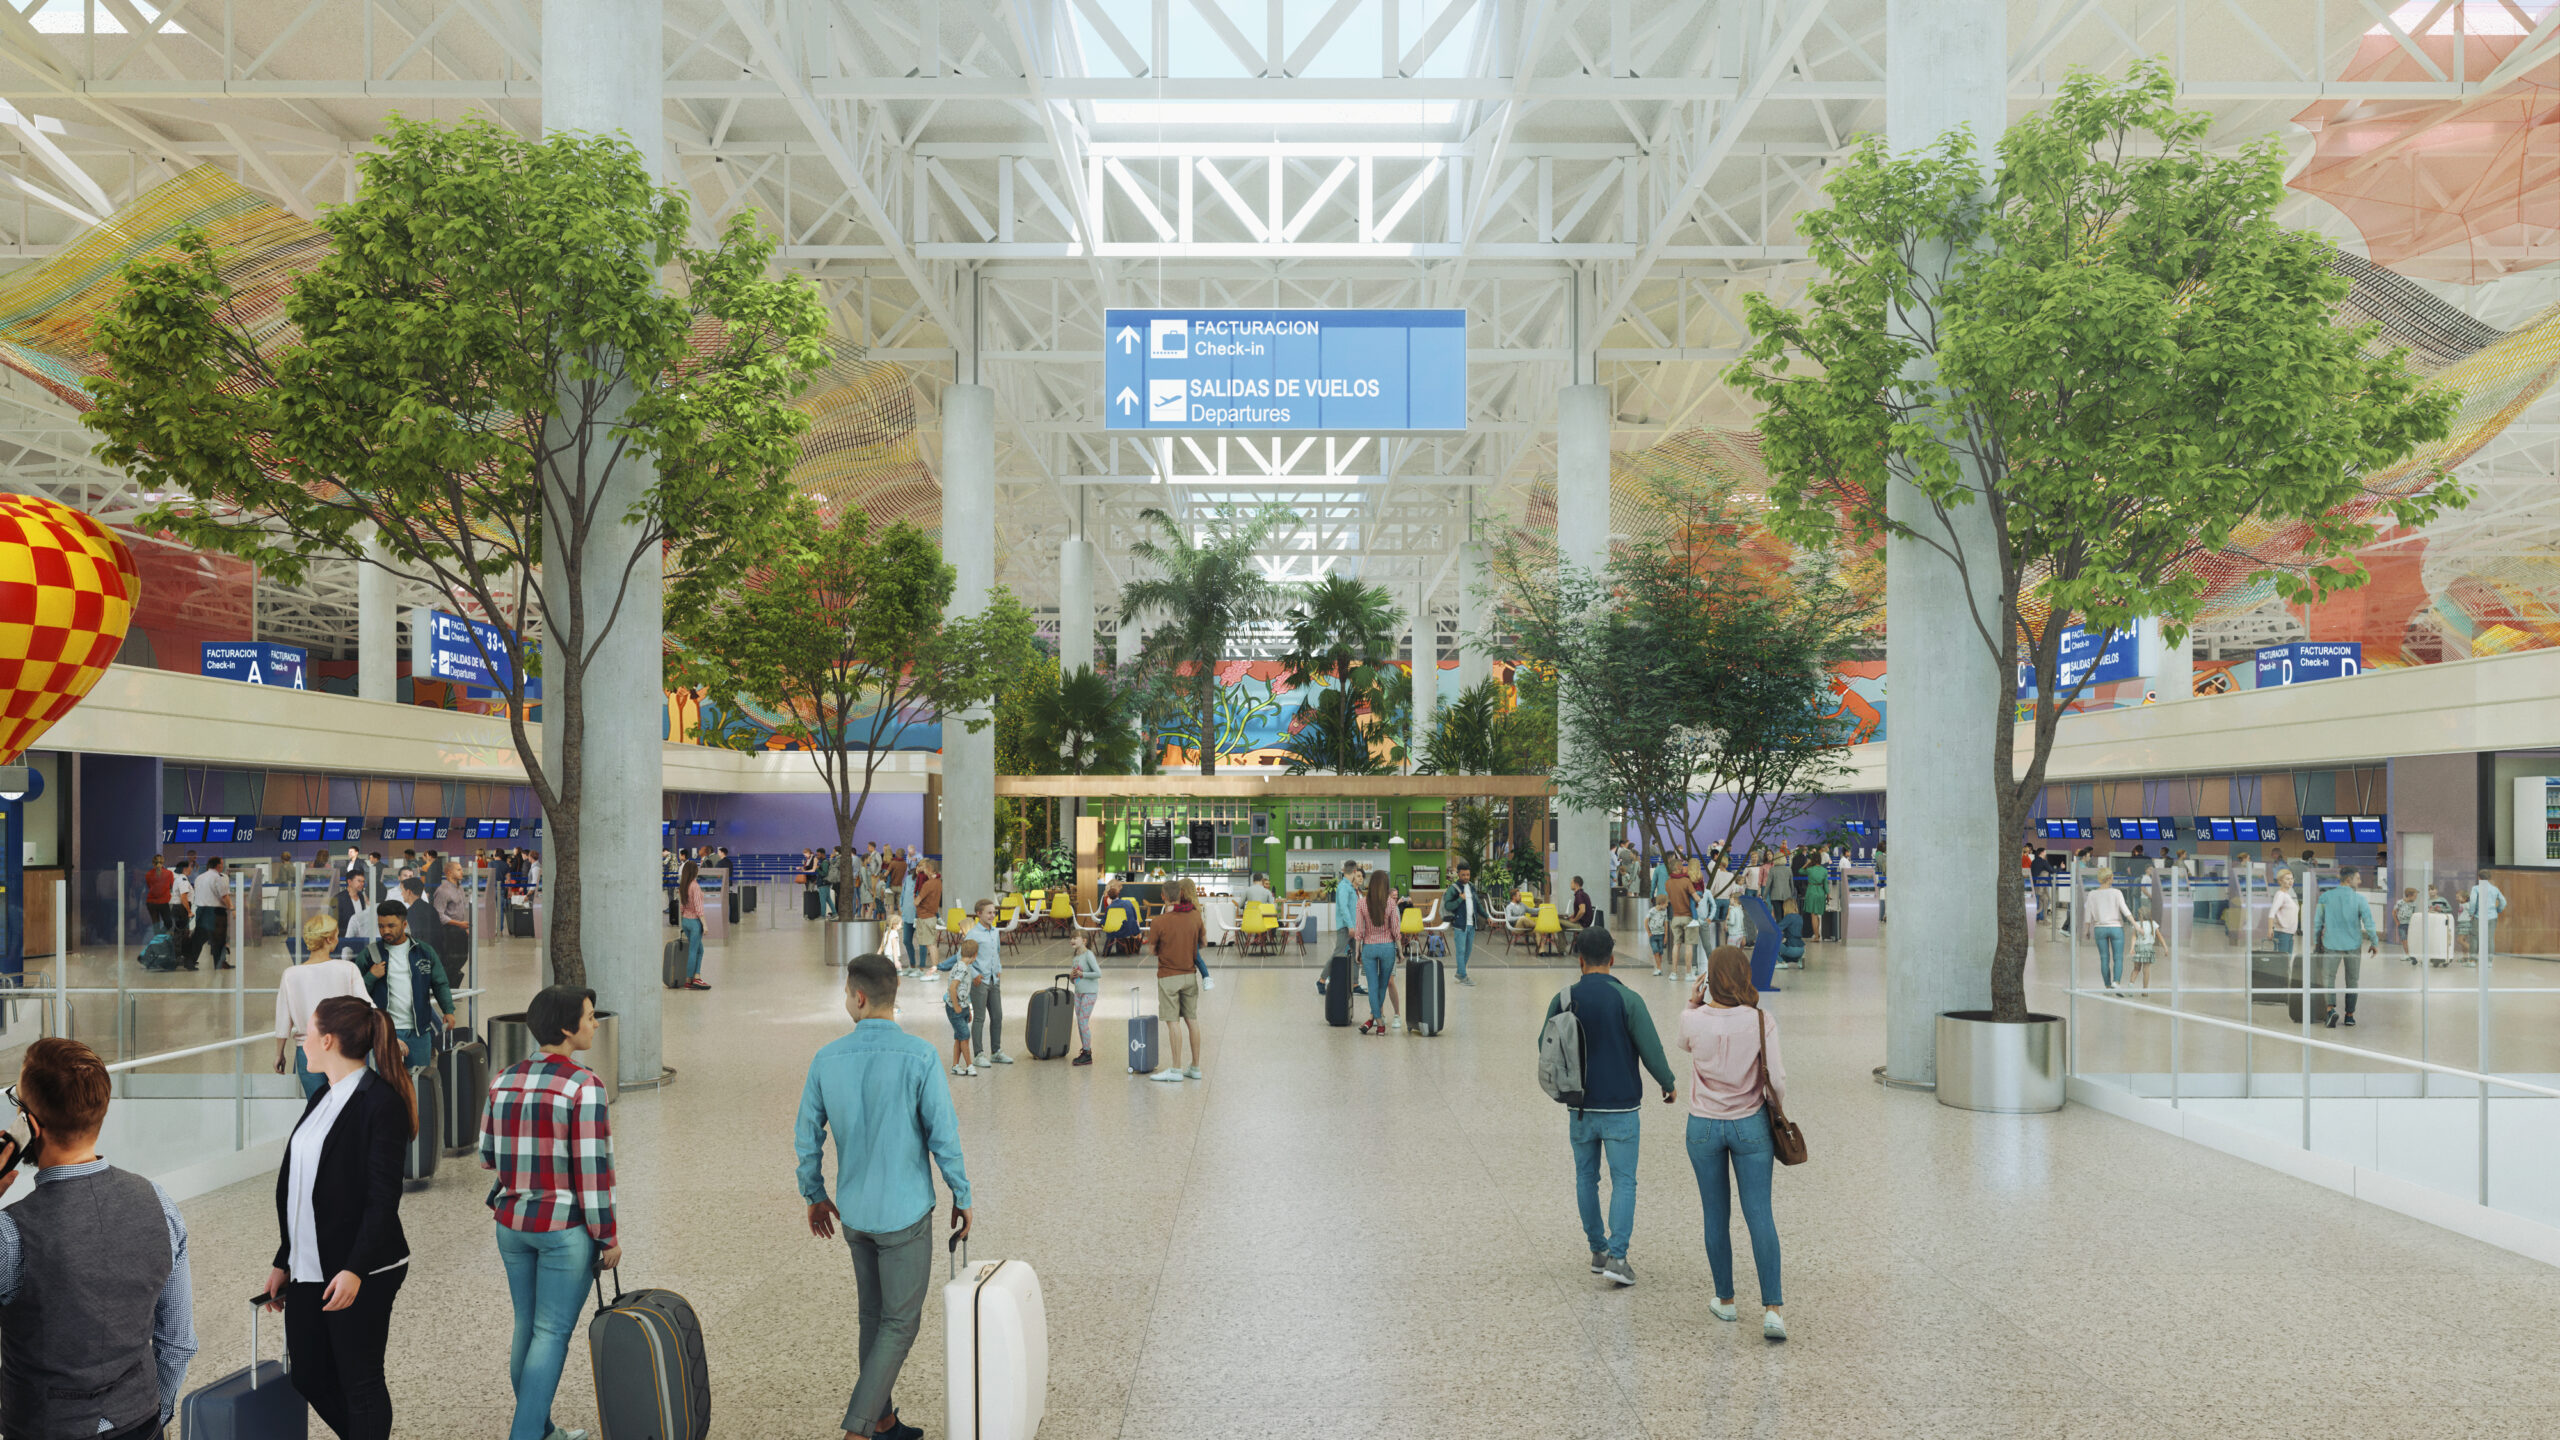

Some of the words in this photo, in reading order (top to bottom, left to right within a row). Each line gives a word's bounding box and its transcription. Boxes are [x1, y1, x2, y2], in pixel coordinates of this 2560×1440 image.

[1195, 321, 1320, 336] FACTURACION
[1195, 341, 1265, 356] Check-in
[1190, 379, 1270, 398] SALIDAS
[1275, 379, 1300, 398] DE
[1305, 379, 1380, 398] VUELOS
[1191, 404, 1291, 426] Departures
[451, 620, 484, 636] FACTUCION
[451, 631, 470, 643] Check-in
[2072, 640, 2090, 650] Check-in
[2300, 646, 2351, 655] FACTURACION
[207, 649, 257, 658] FACTURACION
[270, 650, 300, 663] FACTURACION
[2259, 648, 2289, 660] FACTURACION
[207, 660, 235, 669] Check-in
[270, 661, 288, 672] Check-in
[449, 652, 471, 667] SALIDAS
[472, 656, 479, 668] DE
[479, 657, 498, 671] VUOS
[2070, 658, 2091, 671] SALIDAS
[2259, 661, 2276, 672] Check-in
[2300, 658, 2329, 667] Check-in
[247, 660, 263, 685] A
[293, 665, 304, 690] A
[450, 665, 477, 680] Departures
[2017, 661, 2026, 688] C
[2282, 659, 2293, 686] D
[237, 829, 253, 841] 018
[282, 829, 297, 840] 019
[347, 829, 360, 840] 020
[384, 828, 396, 839] 021
[436, 829, 448, 838] 022
[2109, 828, 2121, 839] 043
[2162, 829, 2174, 839] 044
[2197, 829, 2210, 840] 045
[2261, 829, 2276, 840] 046
[2305, 829, 2320, 841] 047
